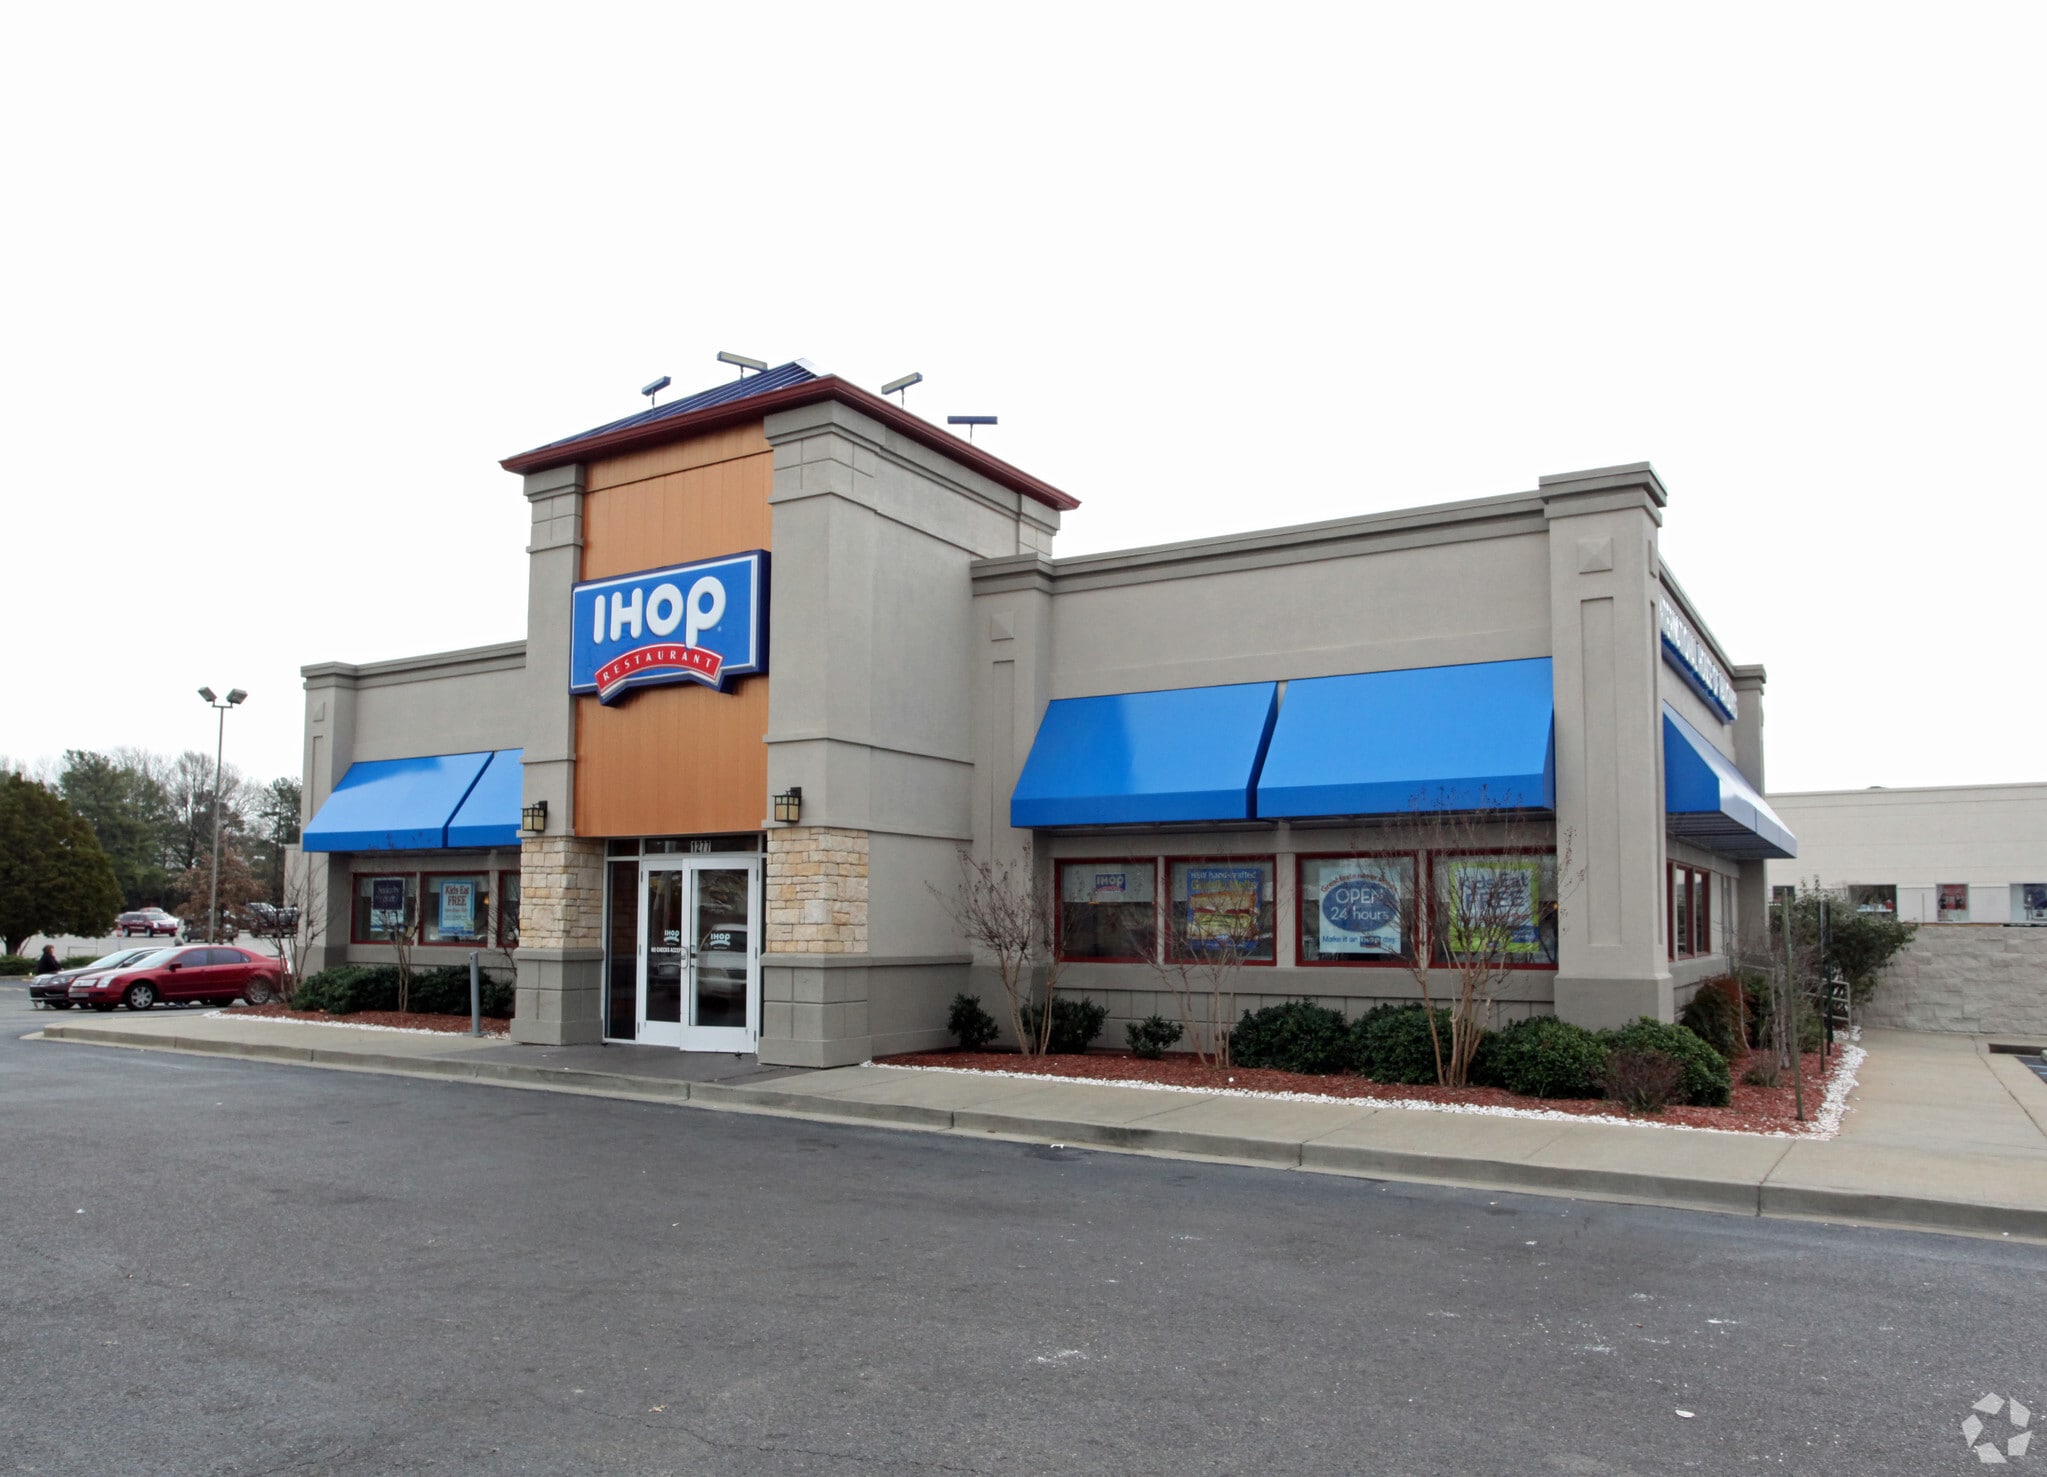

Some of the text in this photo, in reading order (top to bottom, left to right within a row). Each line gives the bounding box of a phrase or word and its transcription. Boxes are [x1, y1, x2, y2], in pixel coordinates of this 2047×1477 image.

[593, 576, 727, 649] IHOP
[602, 650, 713, 681] RESTAURANT
[691, 840, 712, 853] 1277
[445, 885, 470, 895] Kids Eat
[1335, 888, 1384, 904] OPEN
[447, 896, 467, 906] FREE
[1330, 906, 1389, 920] 24 hours
